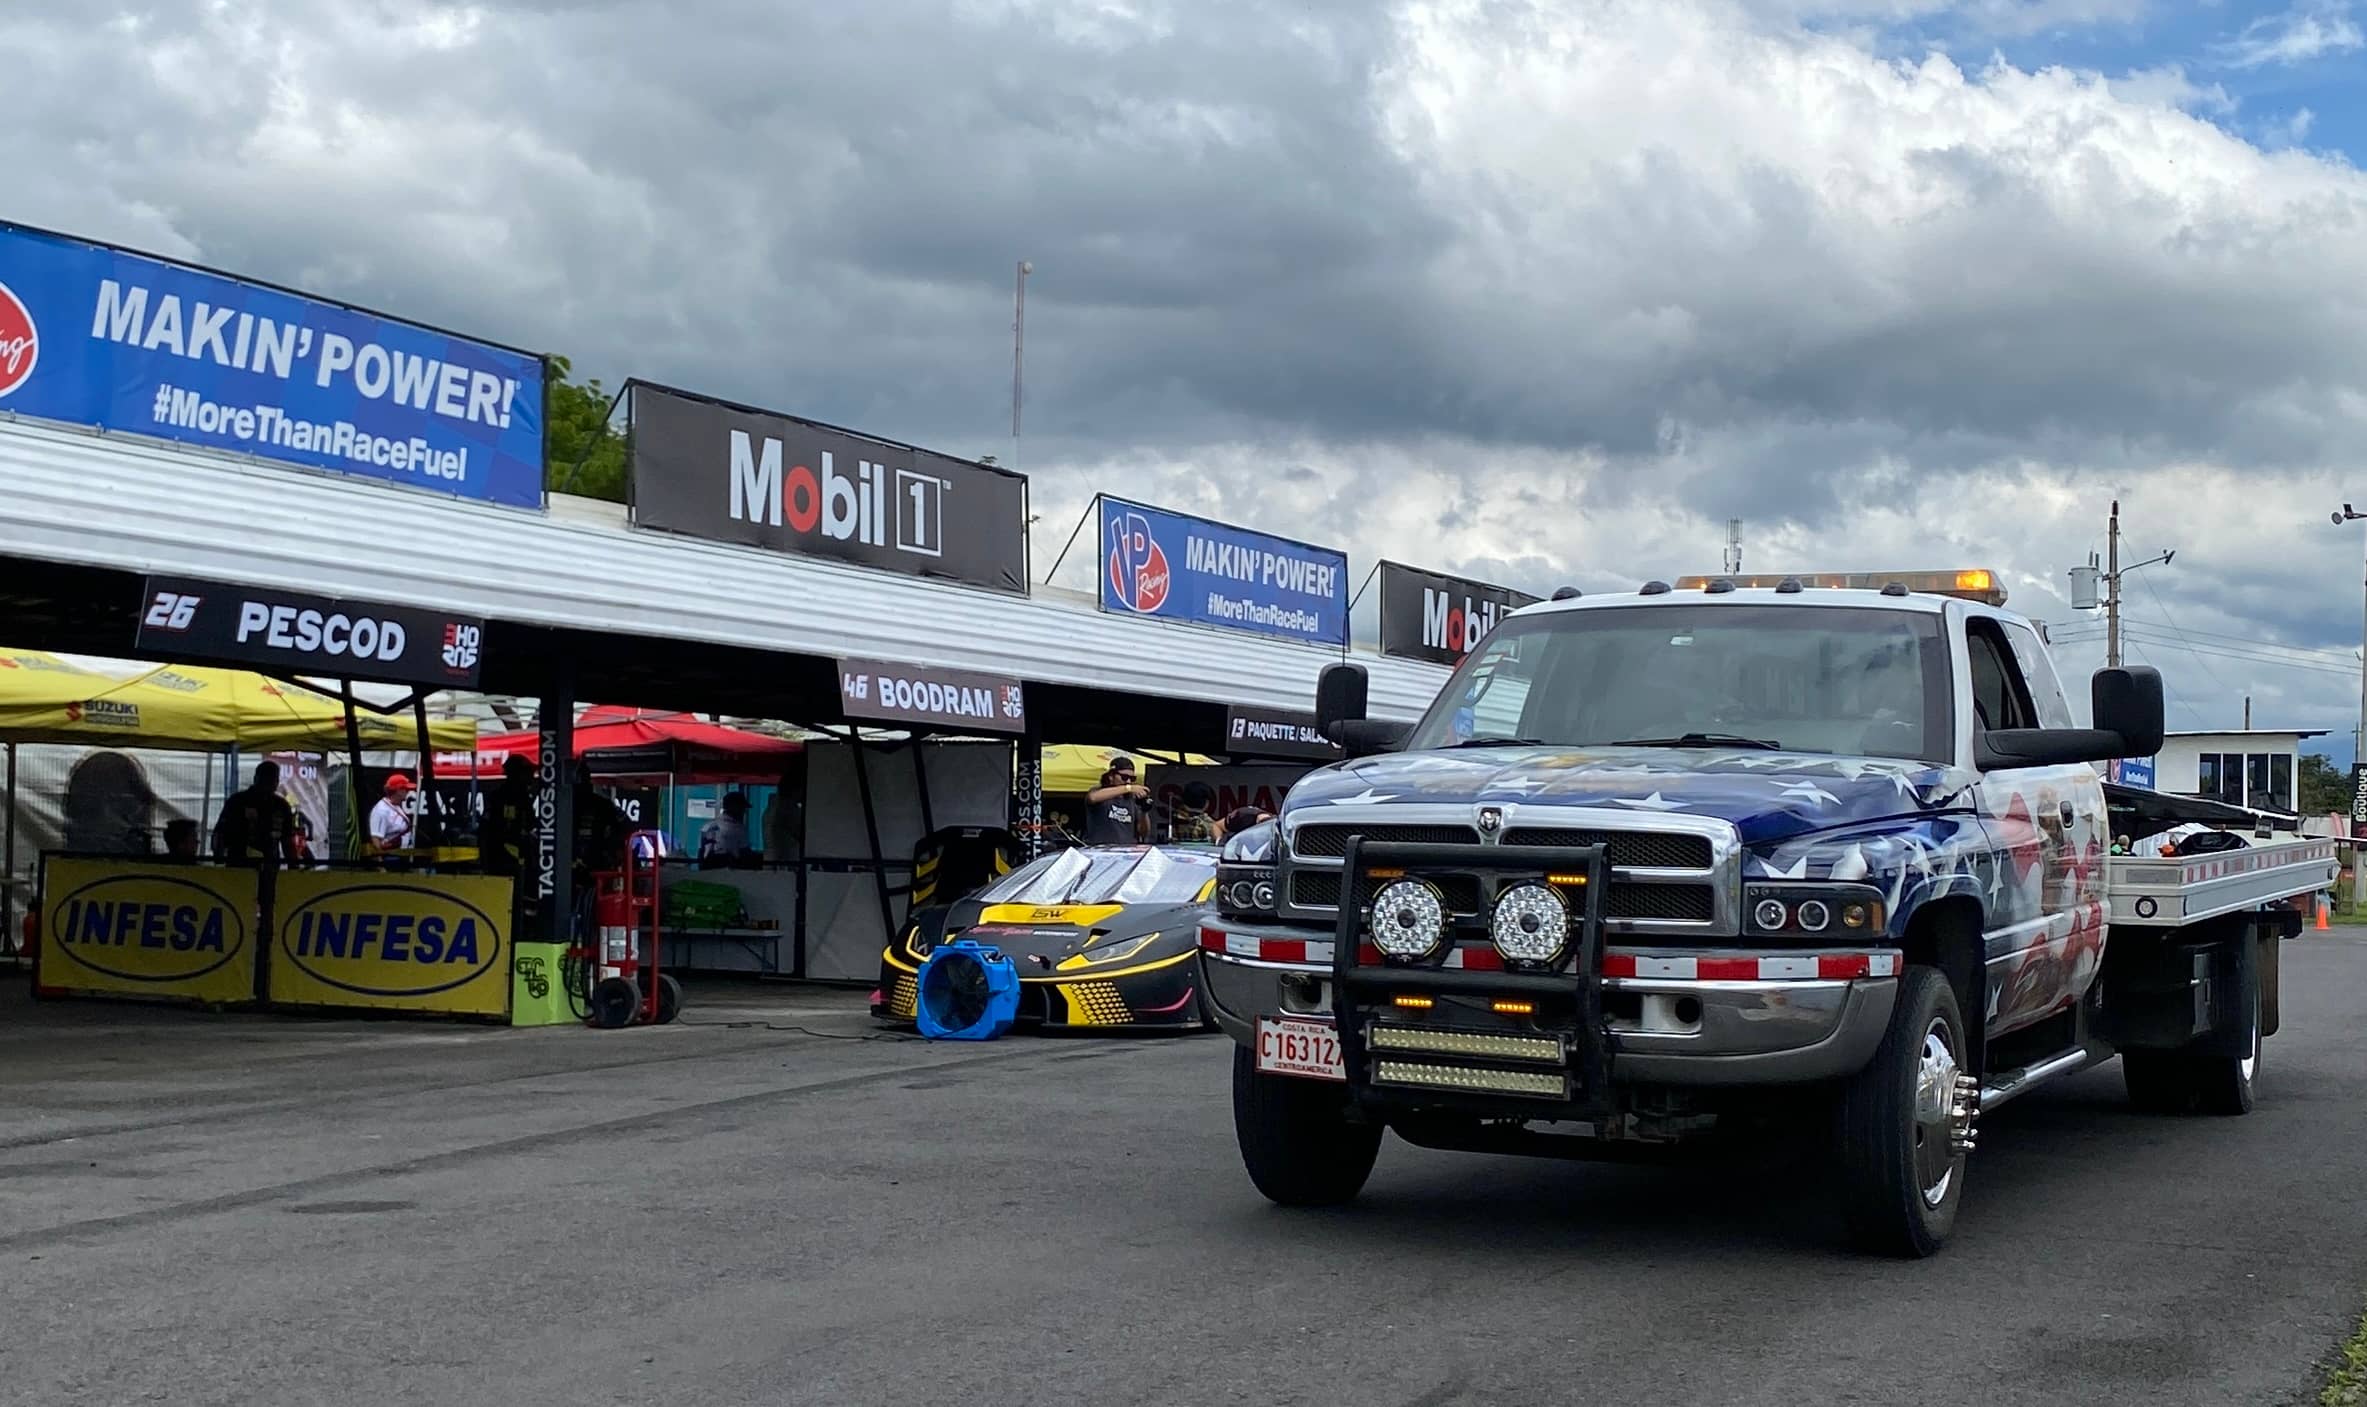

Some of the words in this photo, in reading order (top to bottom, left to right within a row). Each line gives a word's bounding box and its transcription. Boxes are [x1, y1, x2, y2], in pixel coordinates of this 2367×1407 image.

[92, 280, 312, 378] MAKIN'
[316, 333, 515, 429] POWER!
[153, 383, 467, 480] #MoreThanRaceFuel
[730, 430, 885, 546] Mobil
[1186, 536, 1260, 583] MAKIN'
[1263, 553, 1336, 598] POWER!
[145, 592, 200, 630] 26
[237, 601, 406, 662] PESCOD
[1208, 592, 1319, 633] #MoreThanRaceFuel
[86, 700, 138, 714] SUZUKI
[844, 672, 869, 699] 46
[877, 676, 994, 719] BOODRAM
[538, 730, 556, 898] TACTIKOS.COM
[64, 901, 224, 953] INFESA
[297, 911, 479, 964] INFESA
[1283, 1023, 1305, 1033] COSTA
[1309, 1025, 1326, 1034] RICA
